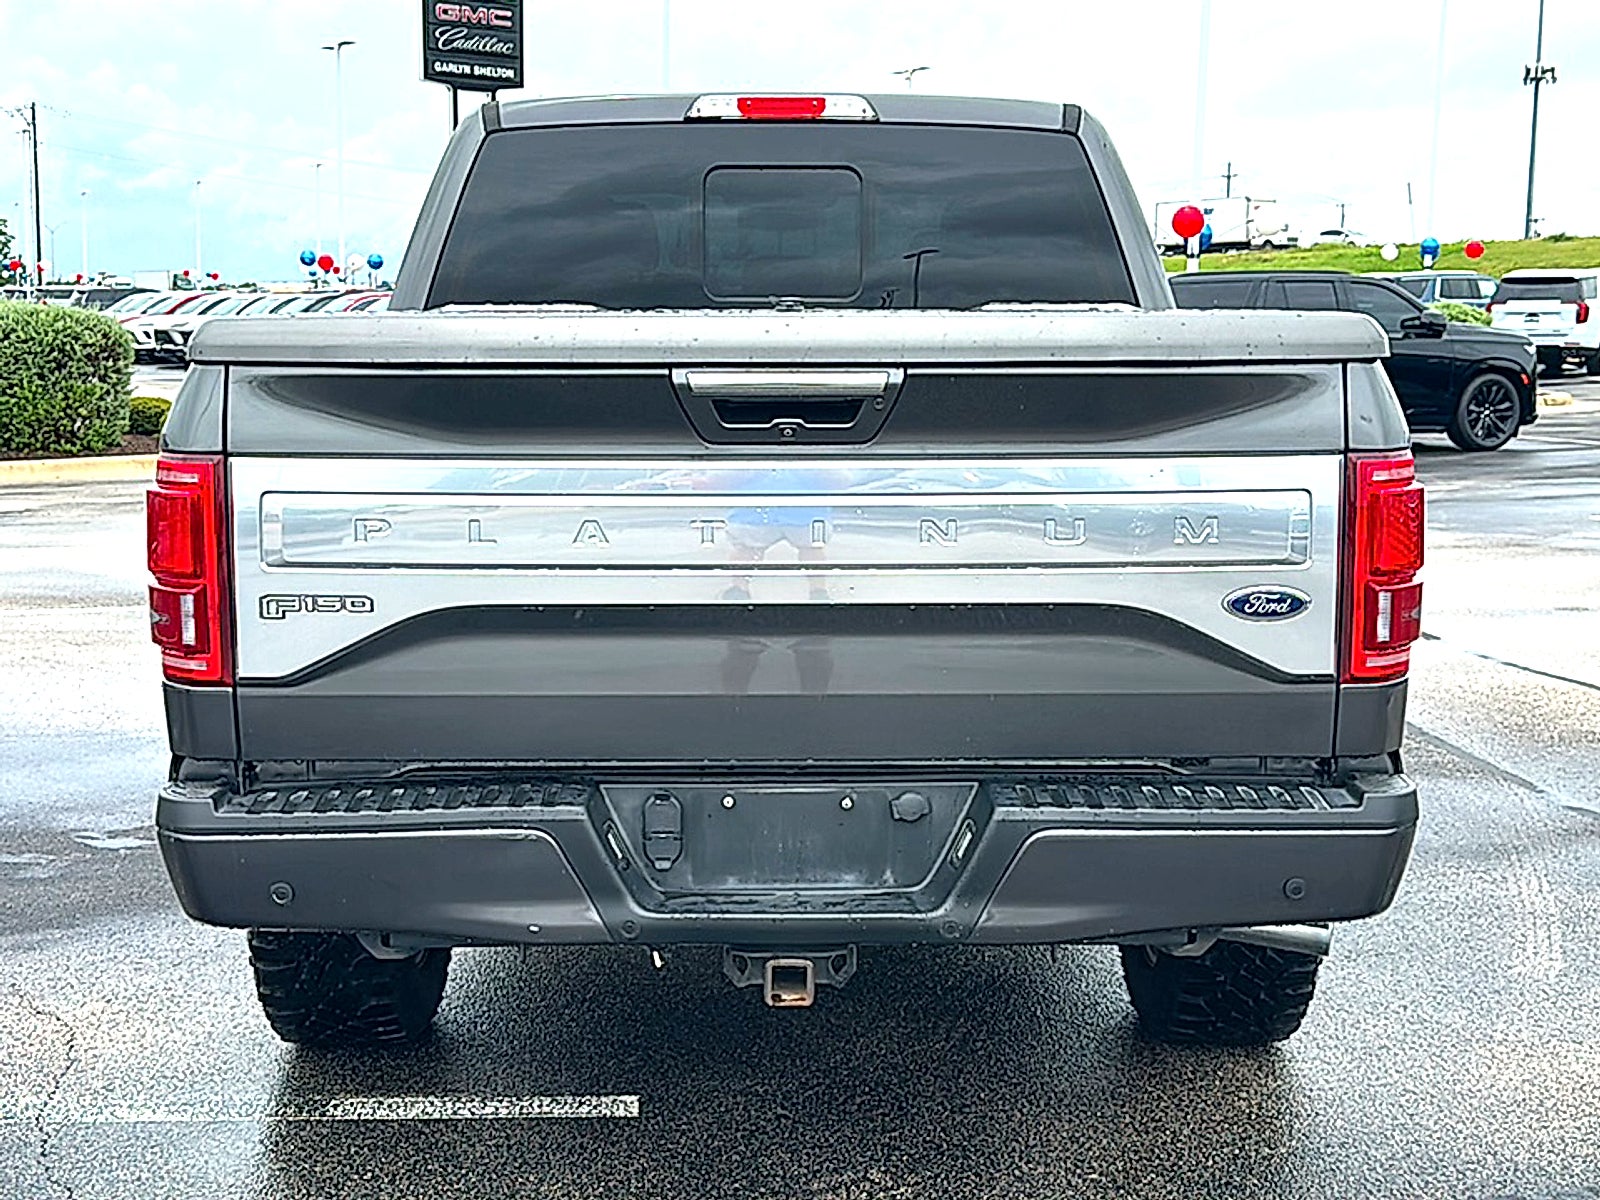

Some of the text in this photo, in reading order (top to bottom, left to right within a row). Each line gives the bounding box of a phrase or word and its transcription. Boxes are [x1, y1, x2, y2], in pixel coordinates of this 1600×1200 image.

[435, 3, 513, 27] GMC
[435, 26, 514, 54] Cadillac
[473, 65, 515, 79] SHELTON
[354, 516, 1219, 547] PLATINUM
[1244, 593, 1292, 614] Ford
